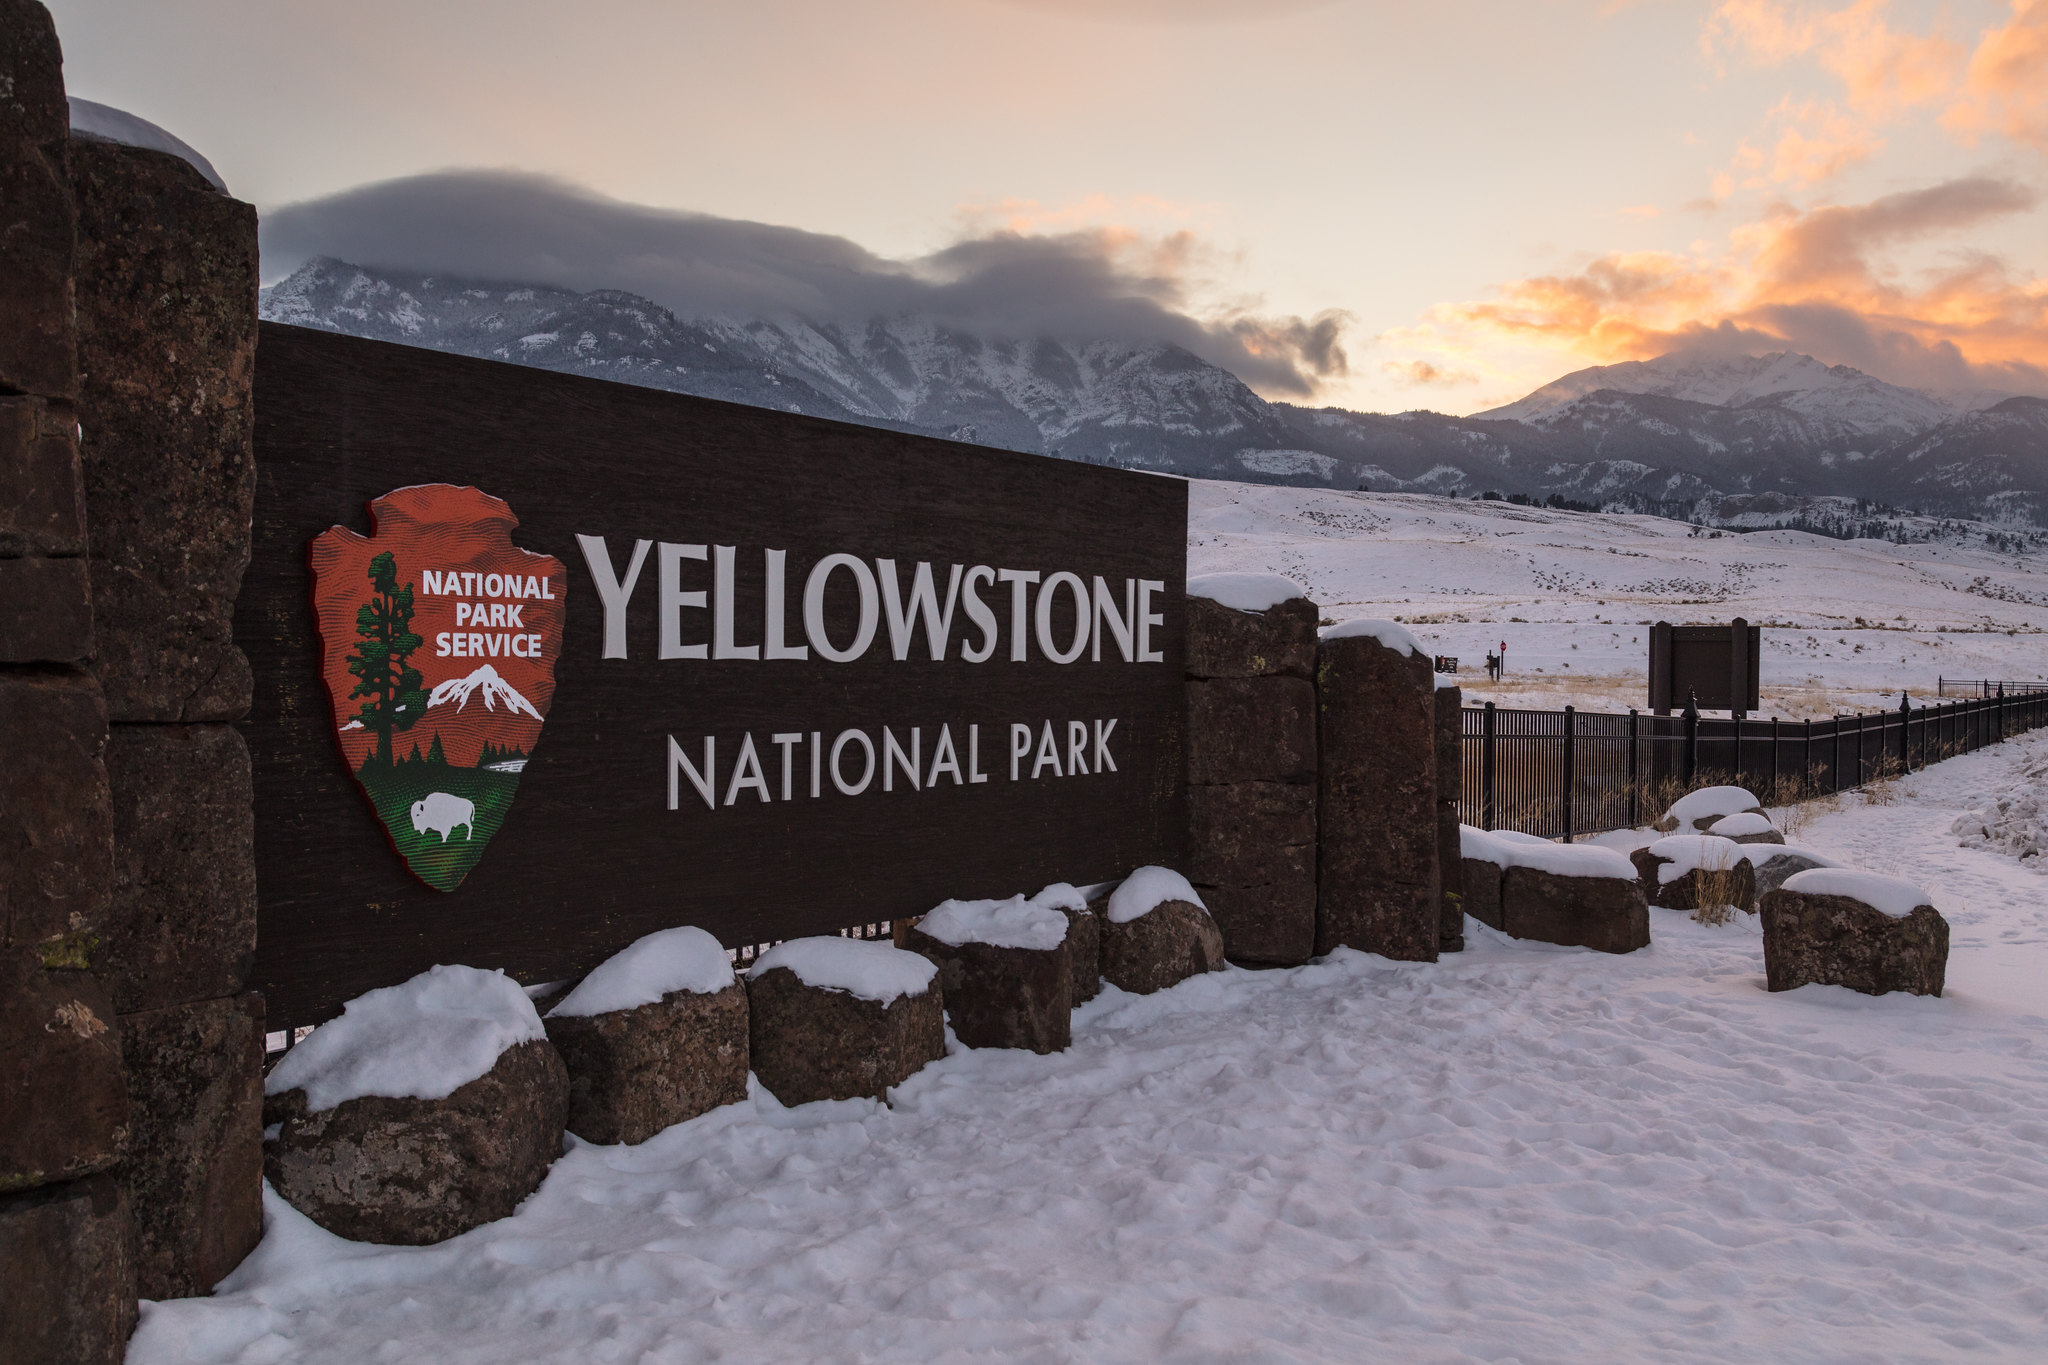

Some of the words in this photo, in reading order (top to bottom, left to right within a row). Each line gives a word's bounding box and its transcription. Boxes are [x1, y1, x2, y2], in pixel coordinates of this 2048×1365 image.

[422, 569, 555, 600] NATIONAL
[576, 533, 1165, 663] YELLOWSTONE
[456, 602, 525, 628] PARK
[436, 631, 542, 658] SERVICE
[667, 723, 988, 811] NATIONAL
[1010, 718, 1118, 781] PARK
